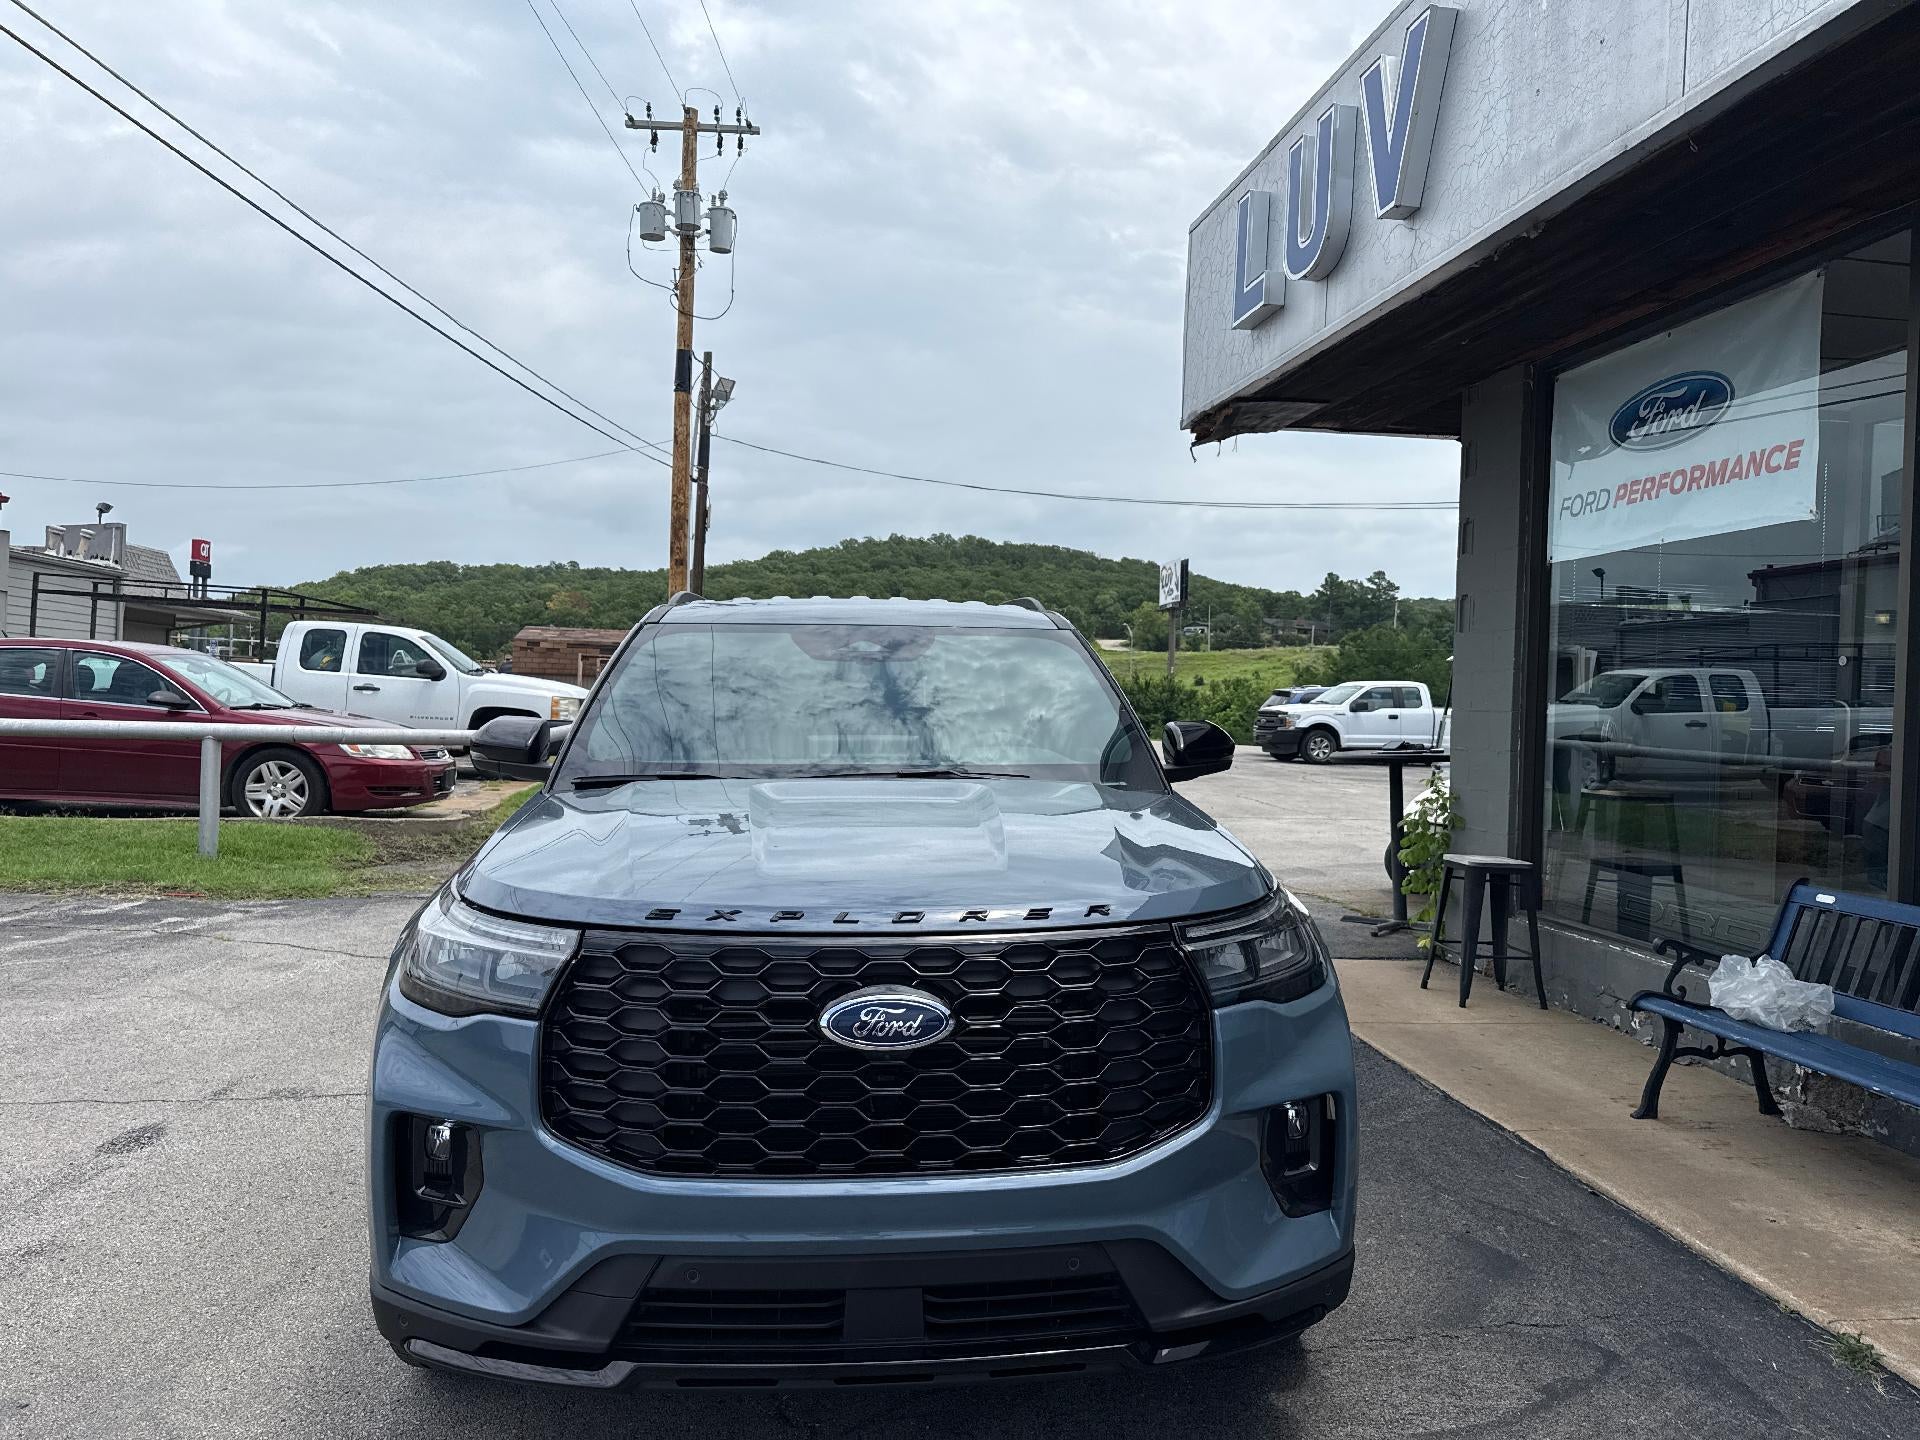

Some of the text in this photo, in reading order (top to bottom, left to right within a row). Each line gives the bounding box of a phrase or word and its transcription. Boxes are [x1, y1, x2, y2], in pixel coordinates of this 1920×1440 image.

[1232, 4, 1458, 330] LUV
[1626, 386, 1707, 441] Ford
[1559, 438, 1806, 520] FORD PERFORMANCE
[644, 903, 1112, 924] EXPLORER
[852, 1006, 924, 1038] Ford
